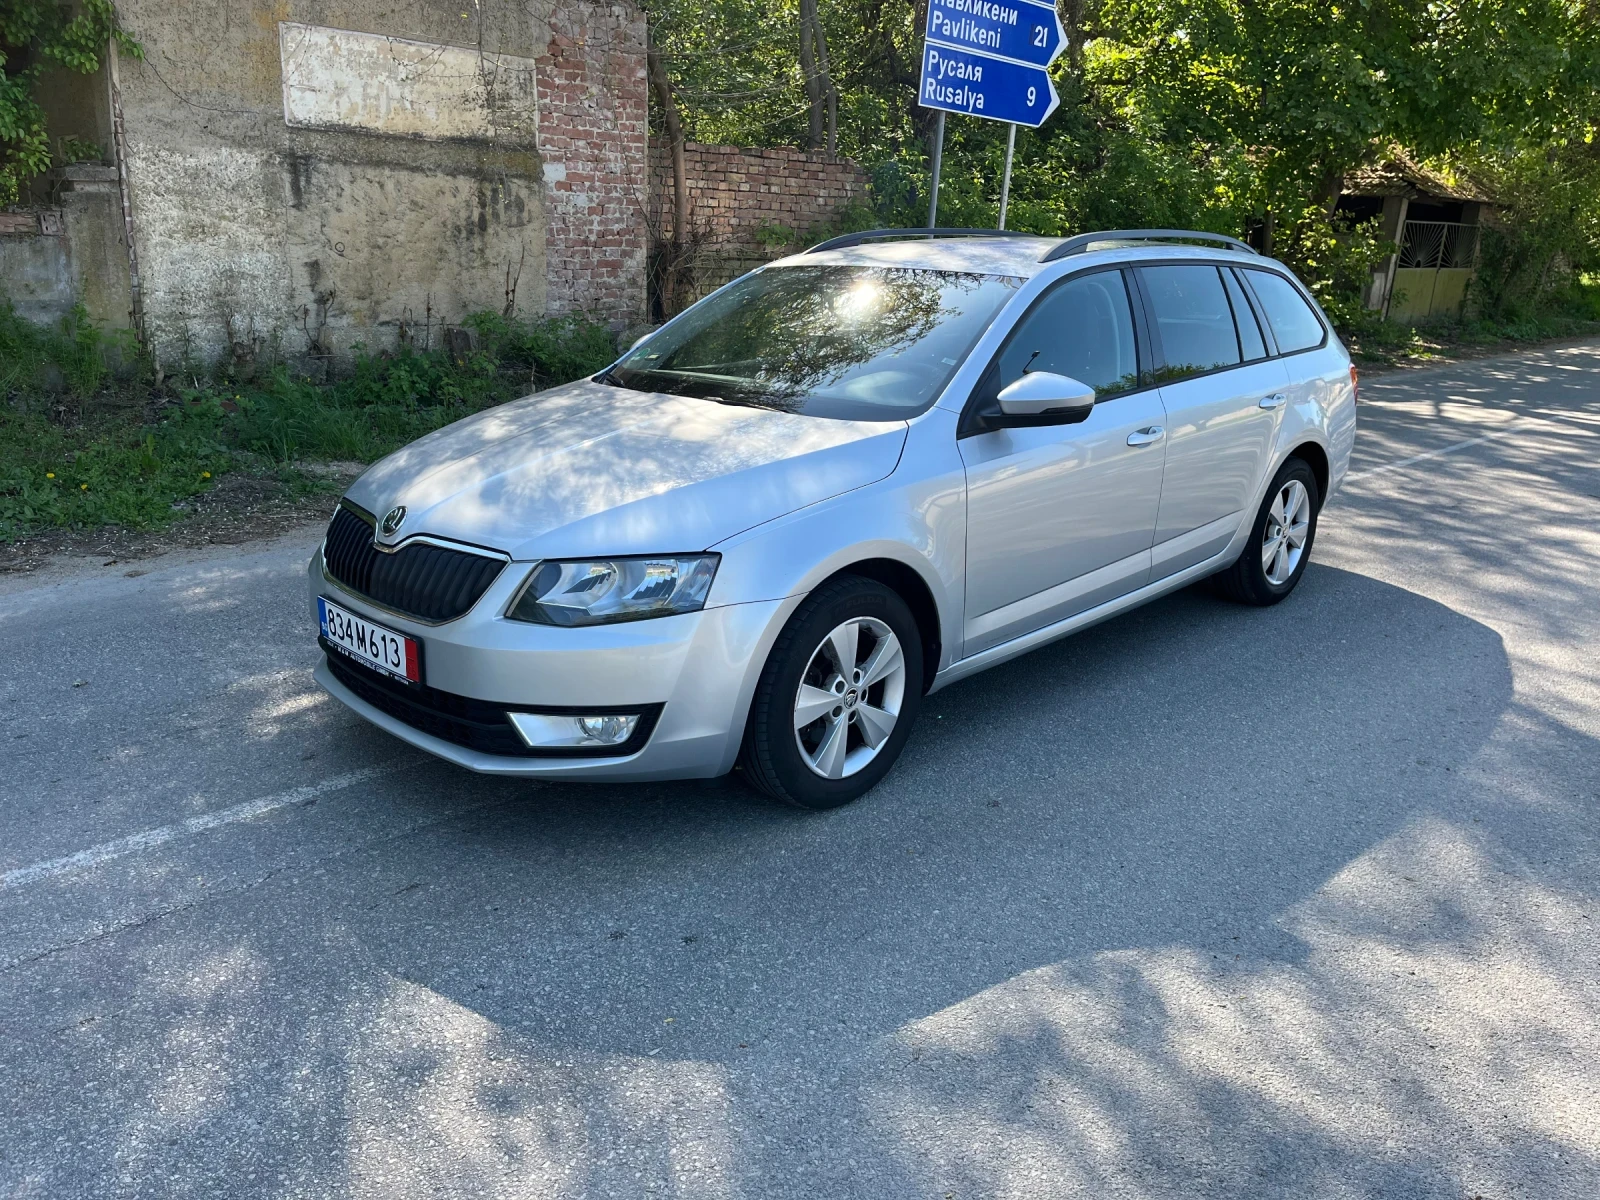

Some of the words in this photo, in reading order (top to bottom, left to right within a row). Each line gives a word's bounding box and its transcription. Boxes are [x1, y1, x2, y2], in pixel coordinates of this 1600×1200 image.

[931, 10, 1001, 48] Pavlikeni
[934, 0, 1018, 26] авликени
[1033, 25, 1049, 48] 21
[927, 50, 983, 83] Русаля
[925, 77, 984, 112] Rusalya
[1026, 86, 1037, 107] 9
[327, 608, 401, 668] 834M613
